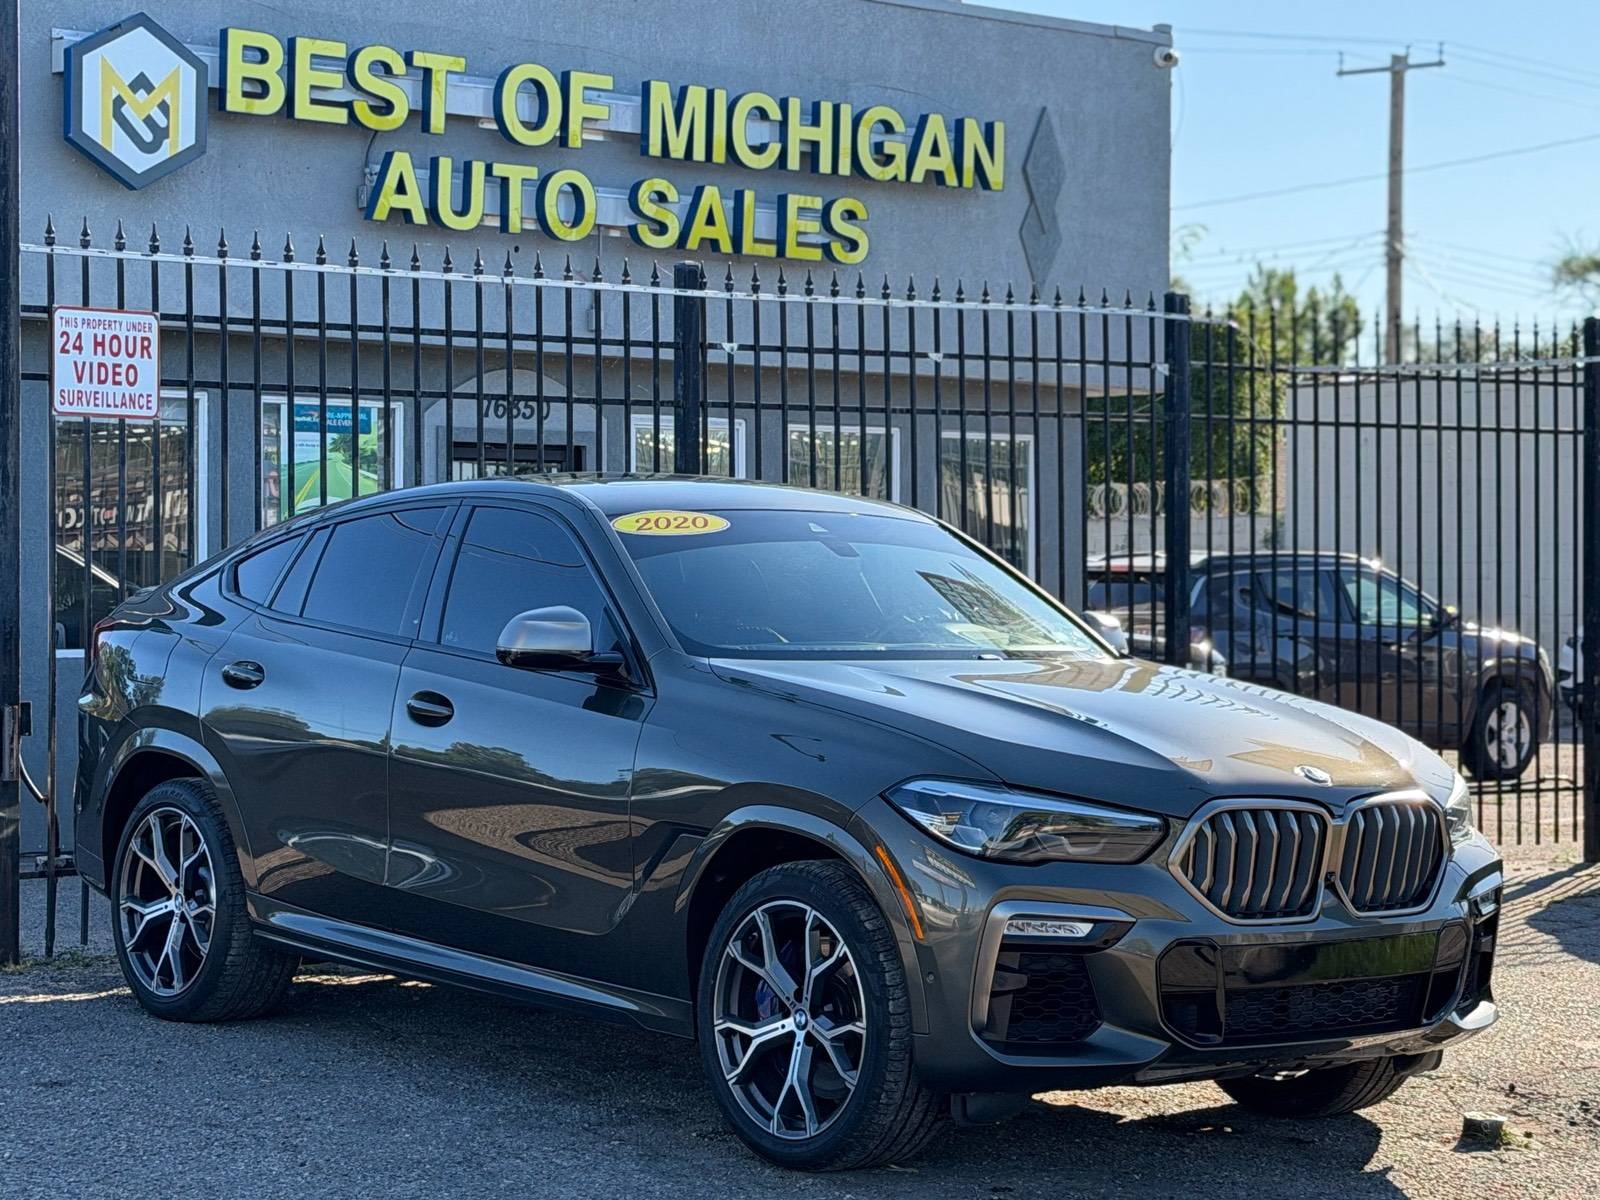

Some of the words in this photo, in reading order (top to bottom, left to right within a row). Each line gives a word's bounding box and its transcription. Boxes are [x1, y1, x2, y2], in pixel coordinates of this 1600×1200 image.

[219, 27, 466, 134] BEST
[495, 62, 614, 149] OF
[641, 79, 1005, 191] MICHIGAN
[365, 150, 598, 242] AUTO
[630, 177, 870, 265] SALES
[59, 316, 78, 328] THIS
[81, 319, 123, 332] PROPERTY
[126, 321, 152, 333] UNDER
[59, 330, 84, 355] 24
[93, 332, 153, 360] HOUR
[73, 360, 139, 387] VIDEO
[59, 388, 153, 410] SURVEILLANCE
[634, 516, 709, 531] 2020
